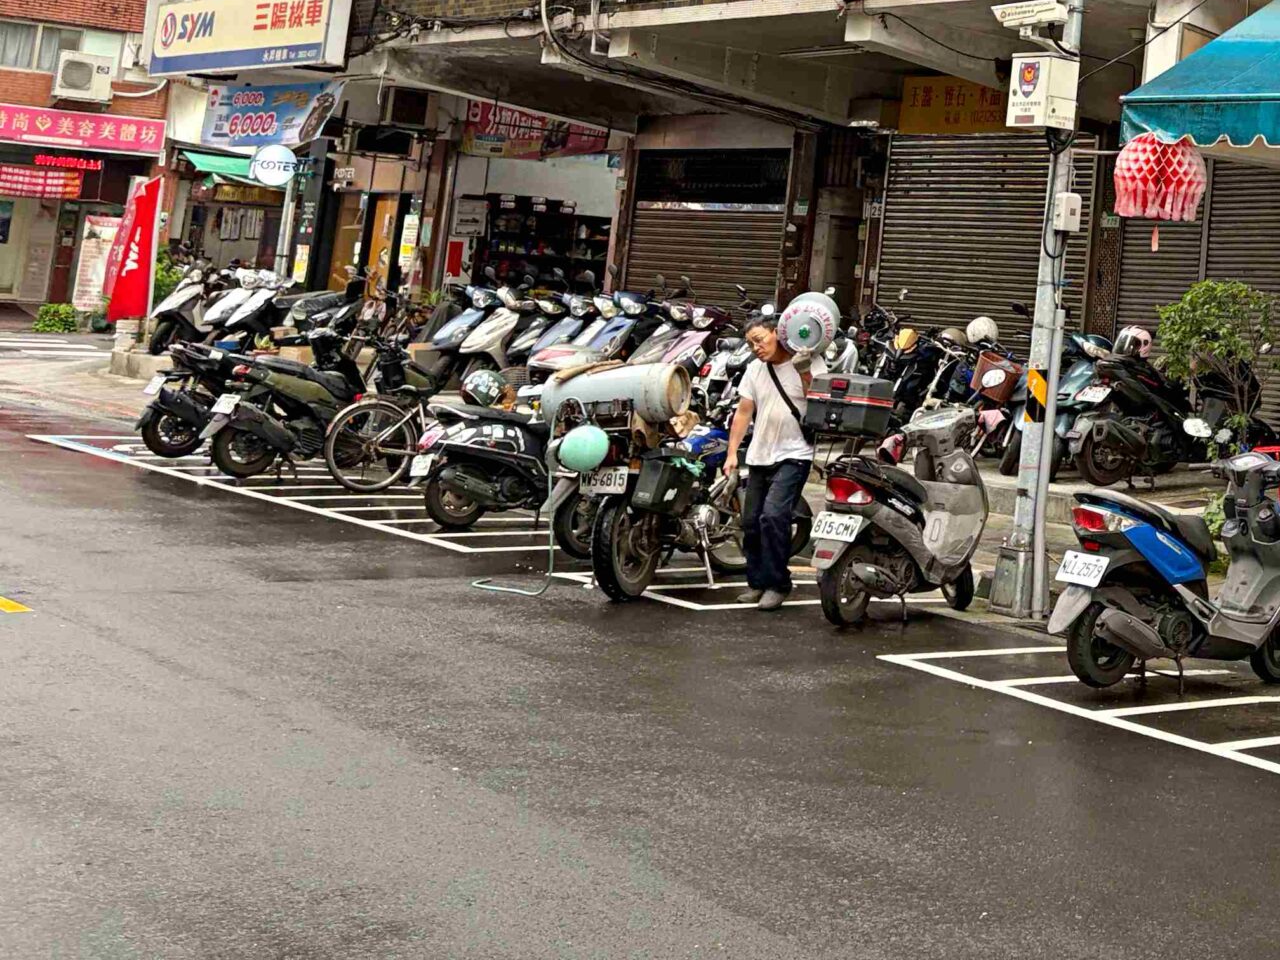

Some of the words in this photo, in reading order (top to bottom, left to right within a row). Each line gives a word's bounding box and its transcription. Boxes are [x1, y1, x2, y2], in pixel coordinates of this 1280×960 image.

[177, 10, 216, 42] SYM
[253, 0, 324, 30] 三陽機車
[56, 117, 158, 143] 美容美體坊
